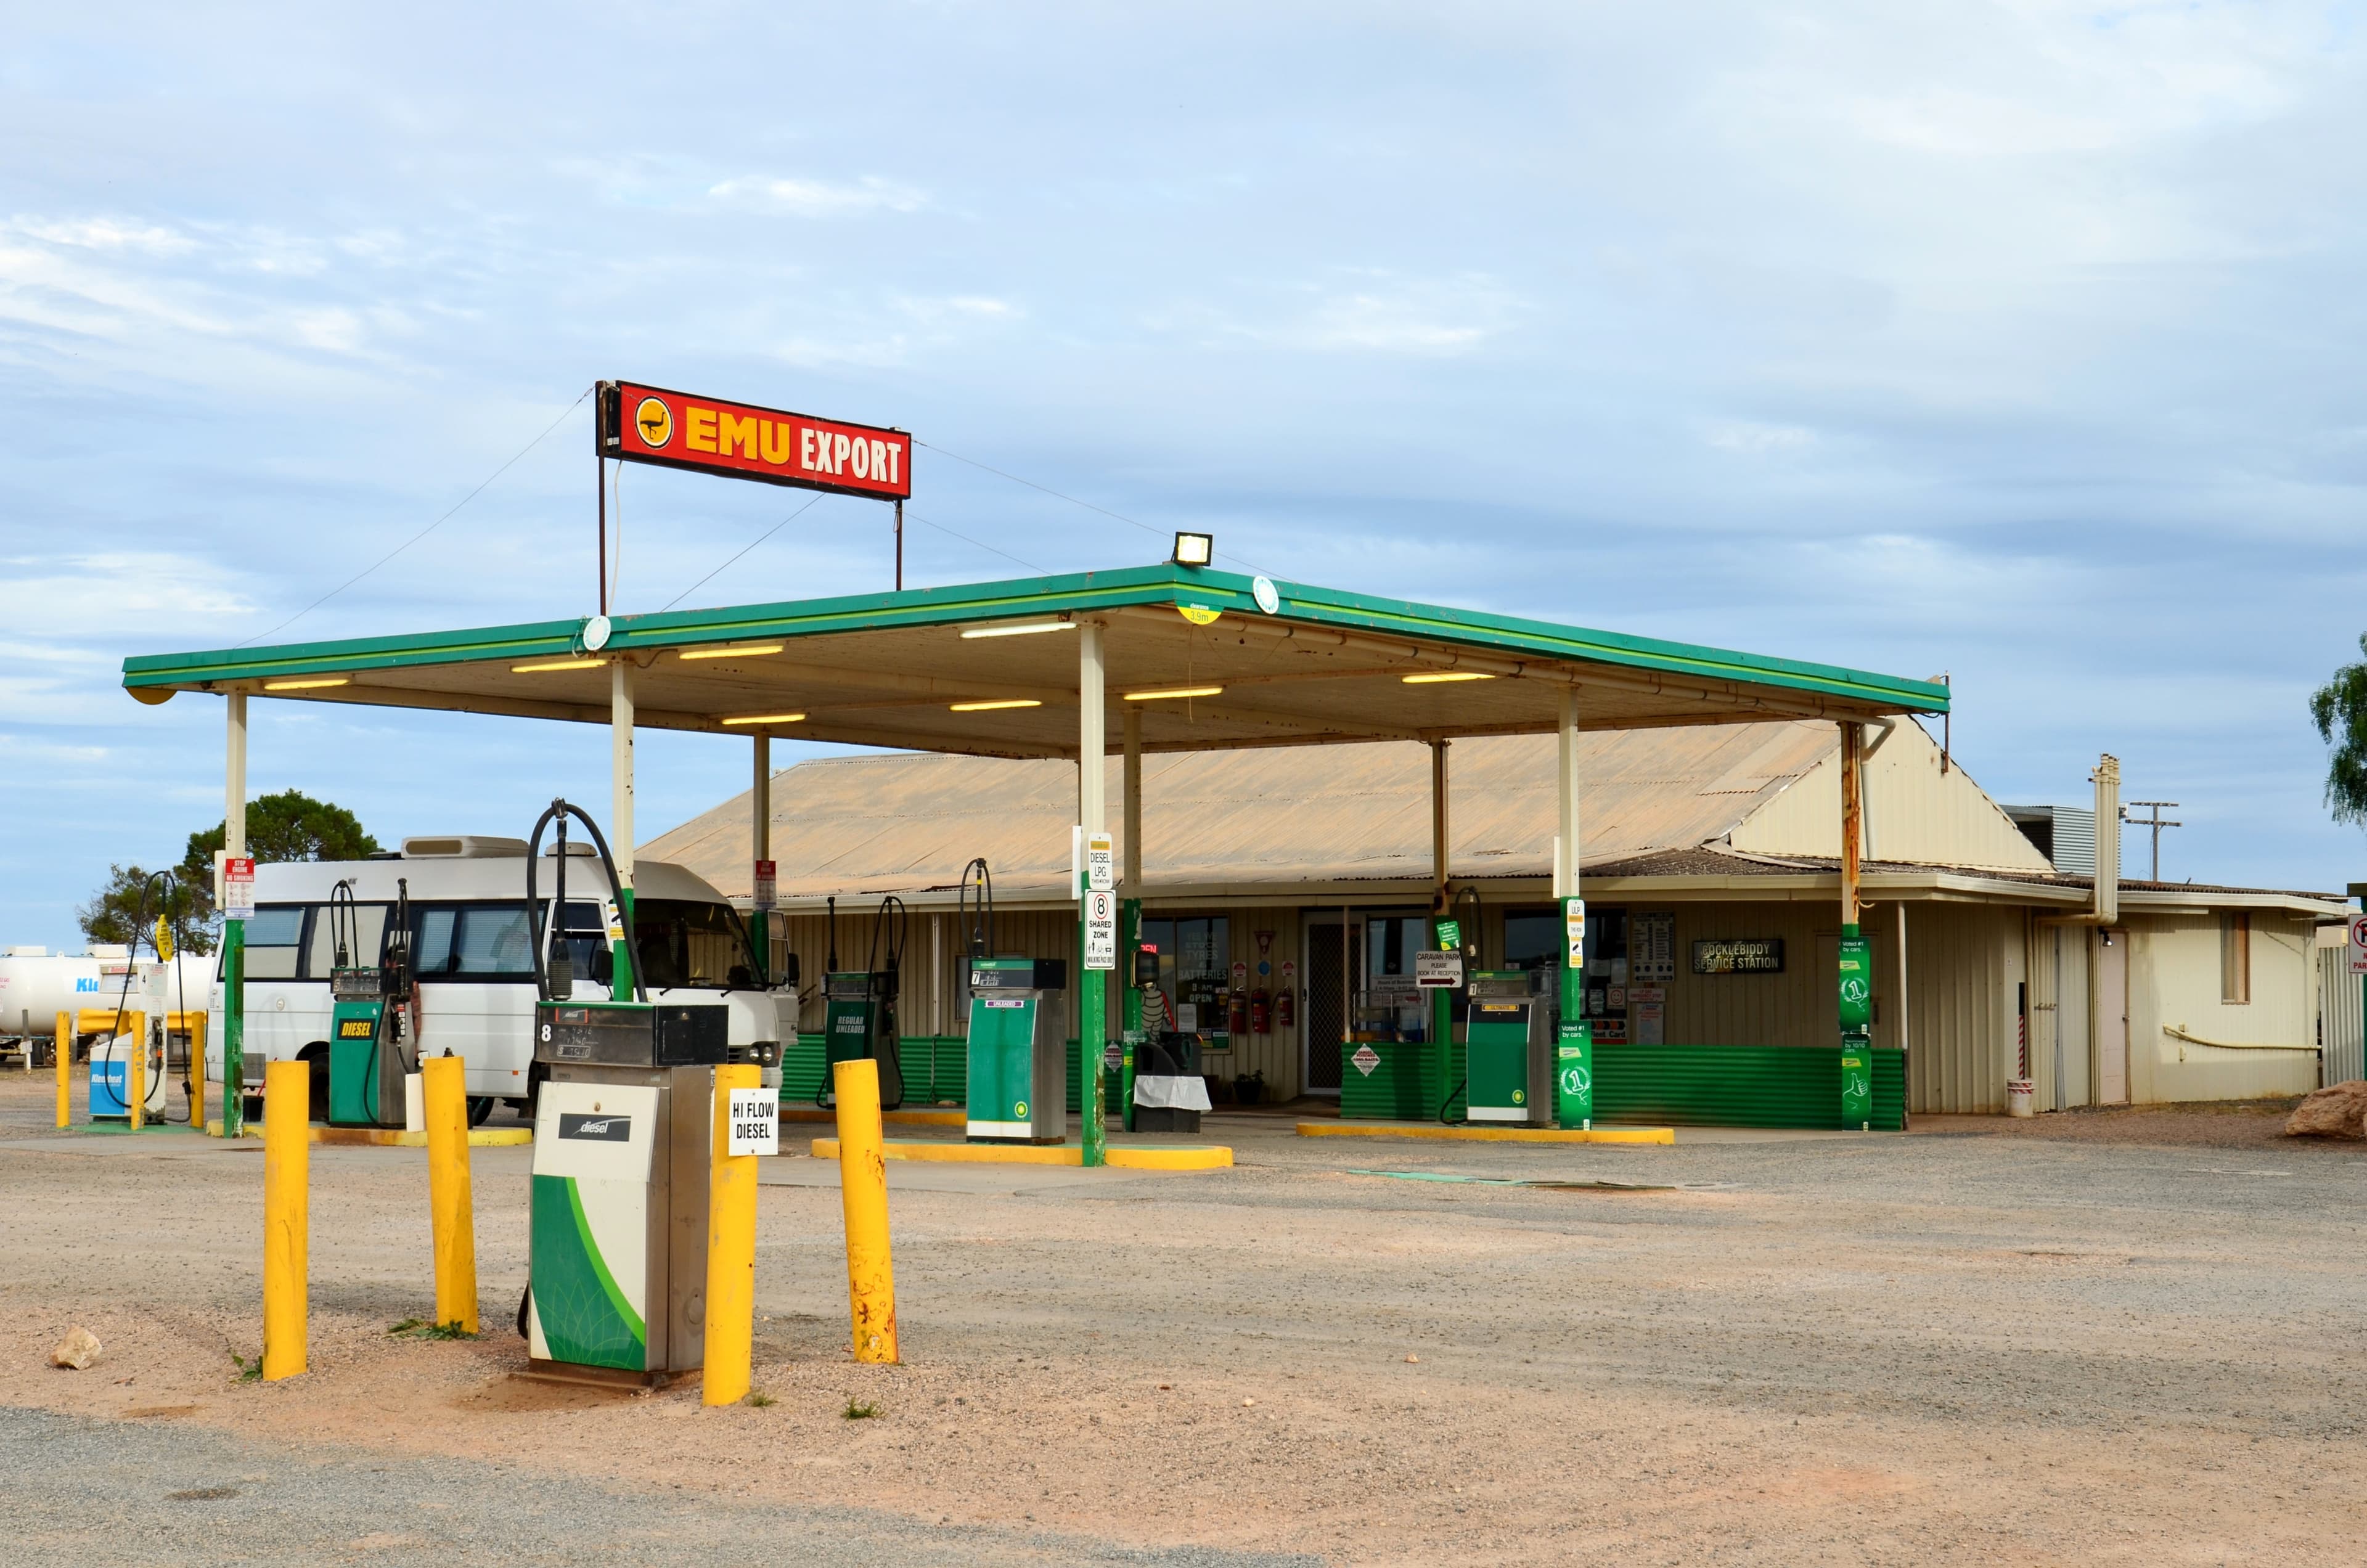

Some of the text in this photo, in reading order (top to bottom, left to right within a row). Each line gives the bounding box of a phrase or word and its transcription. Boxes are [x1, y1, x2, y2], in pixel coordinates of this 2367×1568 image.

[686, 406, 902, 484] EMU EXPORT
[1190, 611, 1209, 622] 3.9m
[1090, 852, 1110, 863] DIESEL
[1095, 866, 1106, 876] LPG
[1098, 898, 1105, 915] 8
[1089, 920, 1112, 928] SHARED
[1186, 950, 1218, 960] TYRES
[1703, 944, 1770, 956] COCKLEBIDDY
[1695, 957, 1778, 969] SERVICE STATION
[142, 975, 146, 984] 4
[974, 972, 979, 983] 7
[1178, 970, 1228, 981] BATTERIES
[334, 979, 340, 991] 5
[1189, 994, 1212, 1003] OPEN
[838, 1016, 864, 1024] REGULAR
[341, 1023, 371, 1036] DIESEL
[541, 1024, 551, 1042] 8
[835, 1025, 865, 1034] UNLEADED
[91, 1074, 122, 1084] Kleeheat
[733, 1102, 774, 1118] HI FLOW
[581, 1121, 608, 1134] diesel
[737, 1123, 771, 1139] DIESEL
